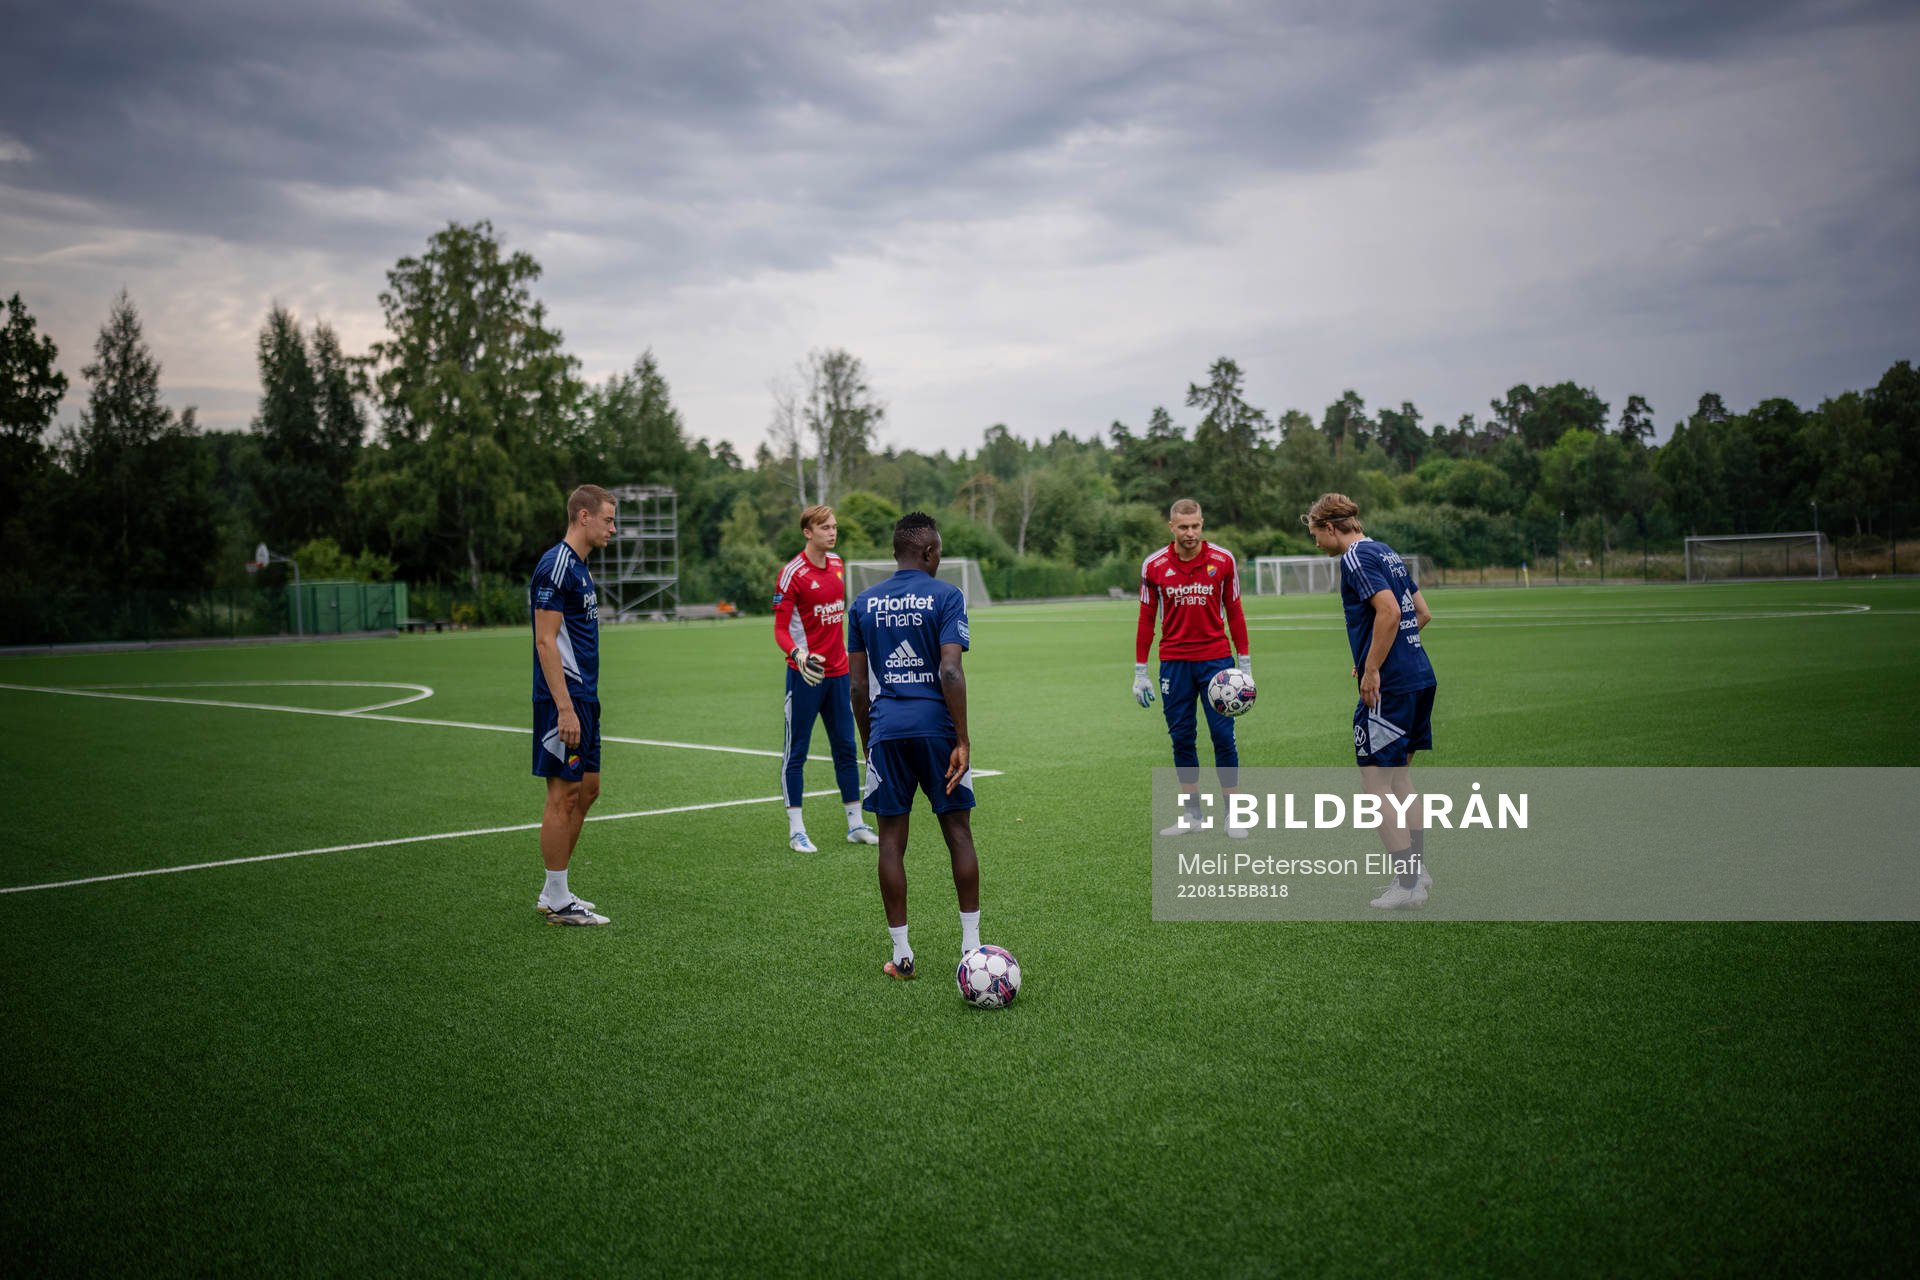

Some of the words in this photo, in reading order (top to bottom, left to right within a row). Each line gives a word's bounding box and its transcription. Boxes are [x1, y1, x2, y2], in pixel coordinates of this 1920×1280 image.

[1165, 582, 1215, 597] Prioritet
[867, 593, 934, 613] Prioritet
[1174, 596, 1207, 607] Finans
[875, 609, 923, 628] Finans
[885, 657, 924, 668] adidas
[884, 671, 934, 684] stadium
